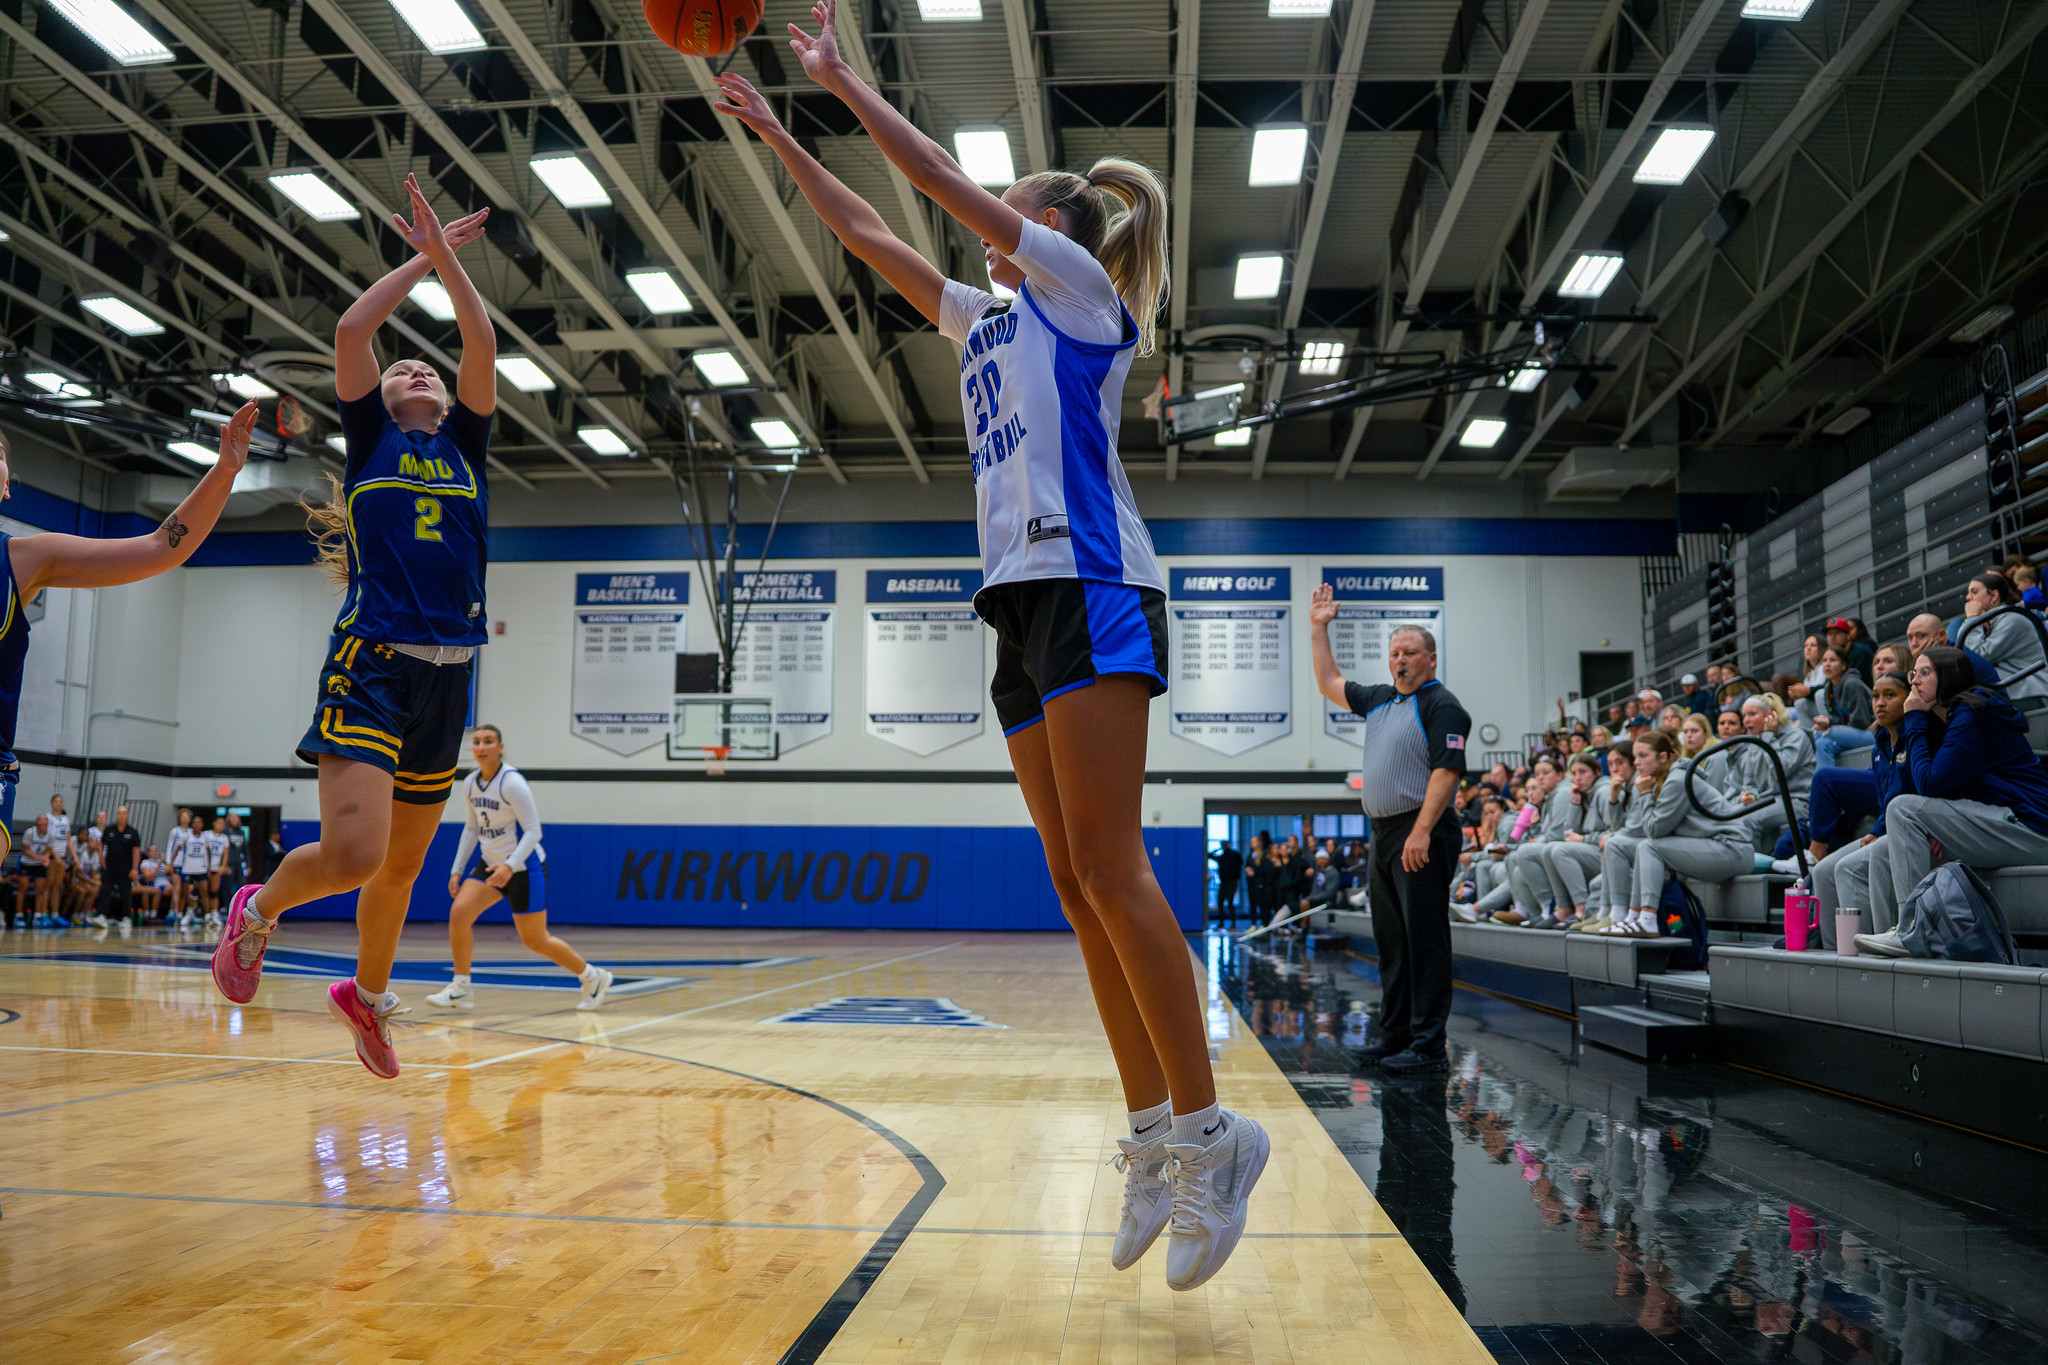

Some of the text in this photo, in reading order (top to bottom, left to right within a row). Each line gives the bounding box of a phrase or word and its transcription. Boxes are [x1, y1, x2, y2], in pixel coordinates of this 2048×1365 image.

[967, 359, 1002, 436] 20
[399, 453, 455, 481] MMU
[415, 497, 443, 542] 2
[609, 575, 656, 588] MEN'S
[743, 573, 813, 587] WOMEN'S
[886, 578, 962, 593] BASEBALL
[1183, 576, 1277, 591] MEN'S GOLF
[1336, 577, 1430, 591] VOLLEYBALL
[587, 588, 677, 602] BASKETBALL
[587, 614, 629, 622] NATIONAL
[960, 713, 975, 722] UP
[1267, 713, 1282, 721] UP
[616, 850, 930, 903] KIRKWOOD
